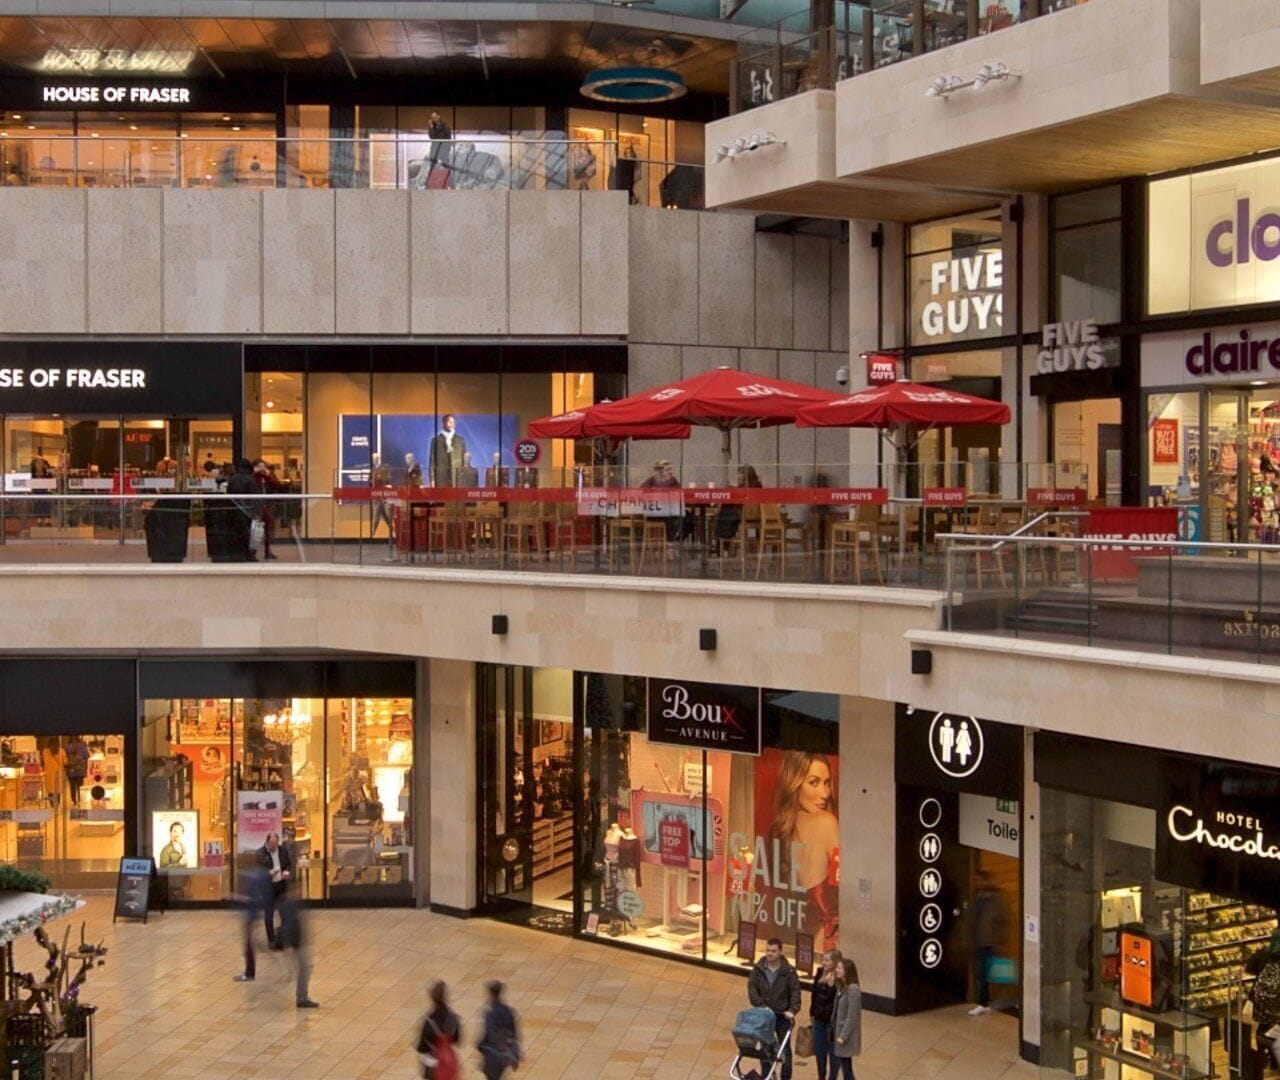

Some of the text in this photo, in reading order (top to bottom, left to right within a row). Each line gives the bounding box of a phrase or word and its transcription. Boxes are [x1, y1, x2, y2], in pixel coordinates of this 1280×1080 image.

[43, 87, 190, 103] HOUSE OF FRASER
[931, 251, 1002, 295] FIVE
[1042, 319, 1099, 347] FIVE
[872, 362, 893, 371] FIVE
[1036, 344, 1106, 374] GUYS
[29, 369, 60, 388] OF
[66, 369, 146, 388] FRASER
[870, 370, 895, 381] GUYS
[831, 492, 872, 500] FIVE GUYS
[928, 492, 962, 501] FIVE GUYS
[1037, 493, 1076, 501] FIVE GUYS
[662, 684, 745, 732] Boux
[679, 727, 728, 742] AVENUE
[1216, 811, 1263, 831] HOTEL
[663, 825, 682, 837] FREE
[987, 819, 1018, 841] Toile
[663, 837, 680, 847] TOP
[729, 832, 807, 893] SALE
[774, 897, 807, 930] OFF
